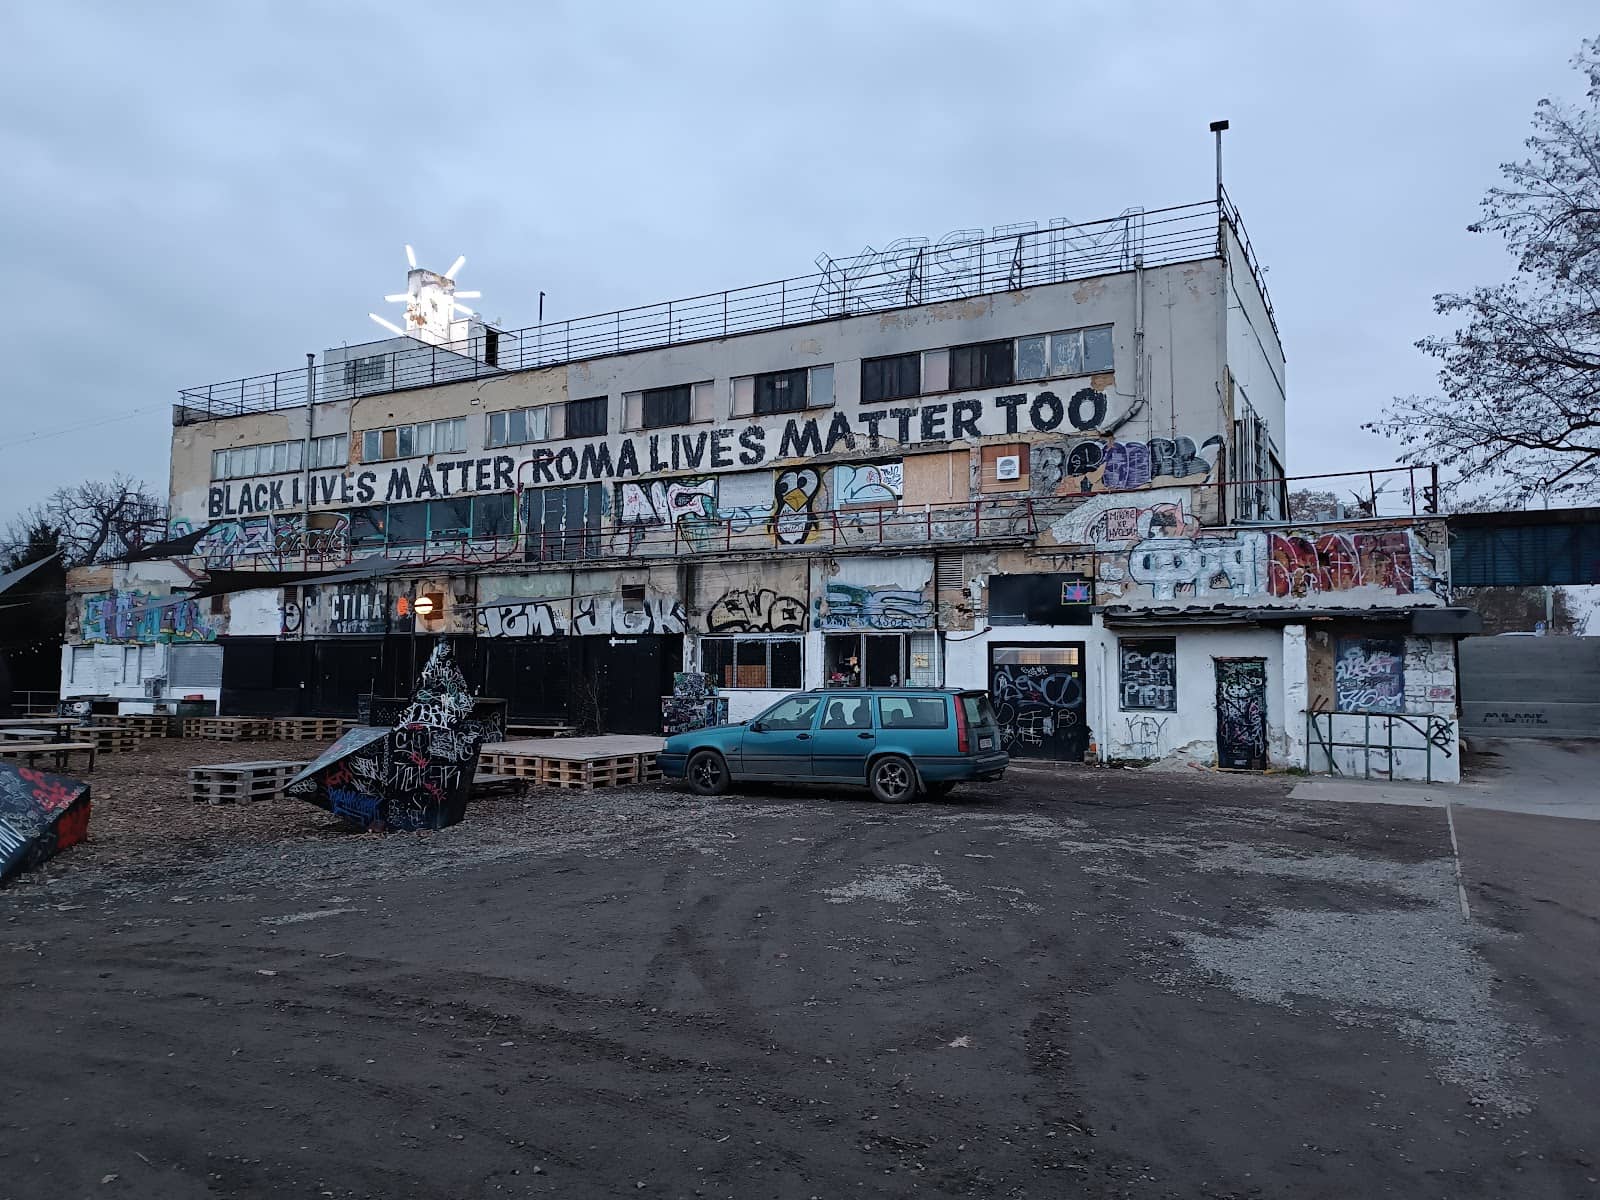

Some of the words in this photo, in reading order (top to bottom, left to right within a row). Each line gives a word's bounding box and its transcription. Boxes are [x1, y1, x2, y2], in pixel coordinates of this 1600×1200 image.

[208, 480, 284, 517] BLACK
[293, 471, 376, 506] LIVES
[386, 455, 515, 500] MATTER
[532, 439, 640, 483] ROMA
[650, 425, 765, 472] LIVES
[778, 397, 983, 457] MATTER
[996, 388, 1107, 433] TOO
